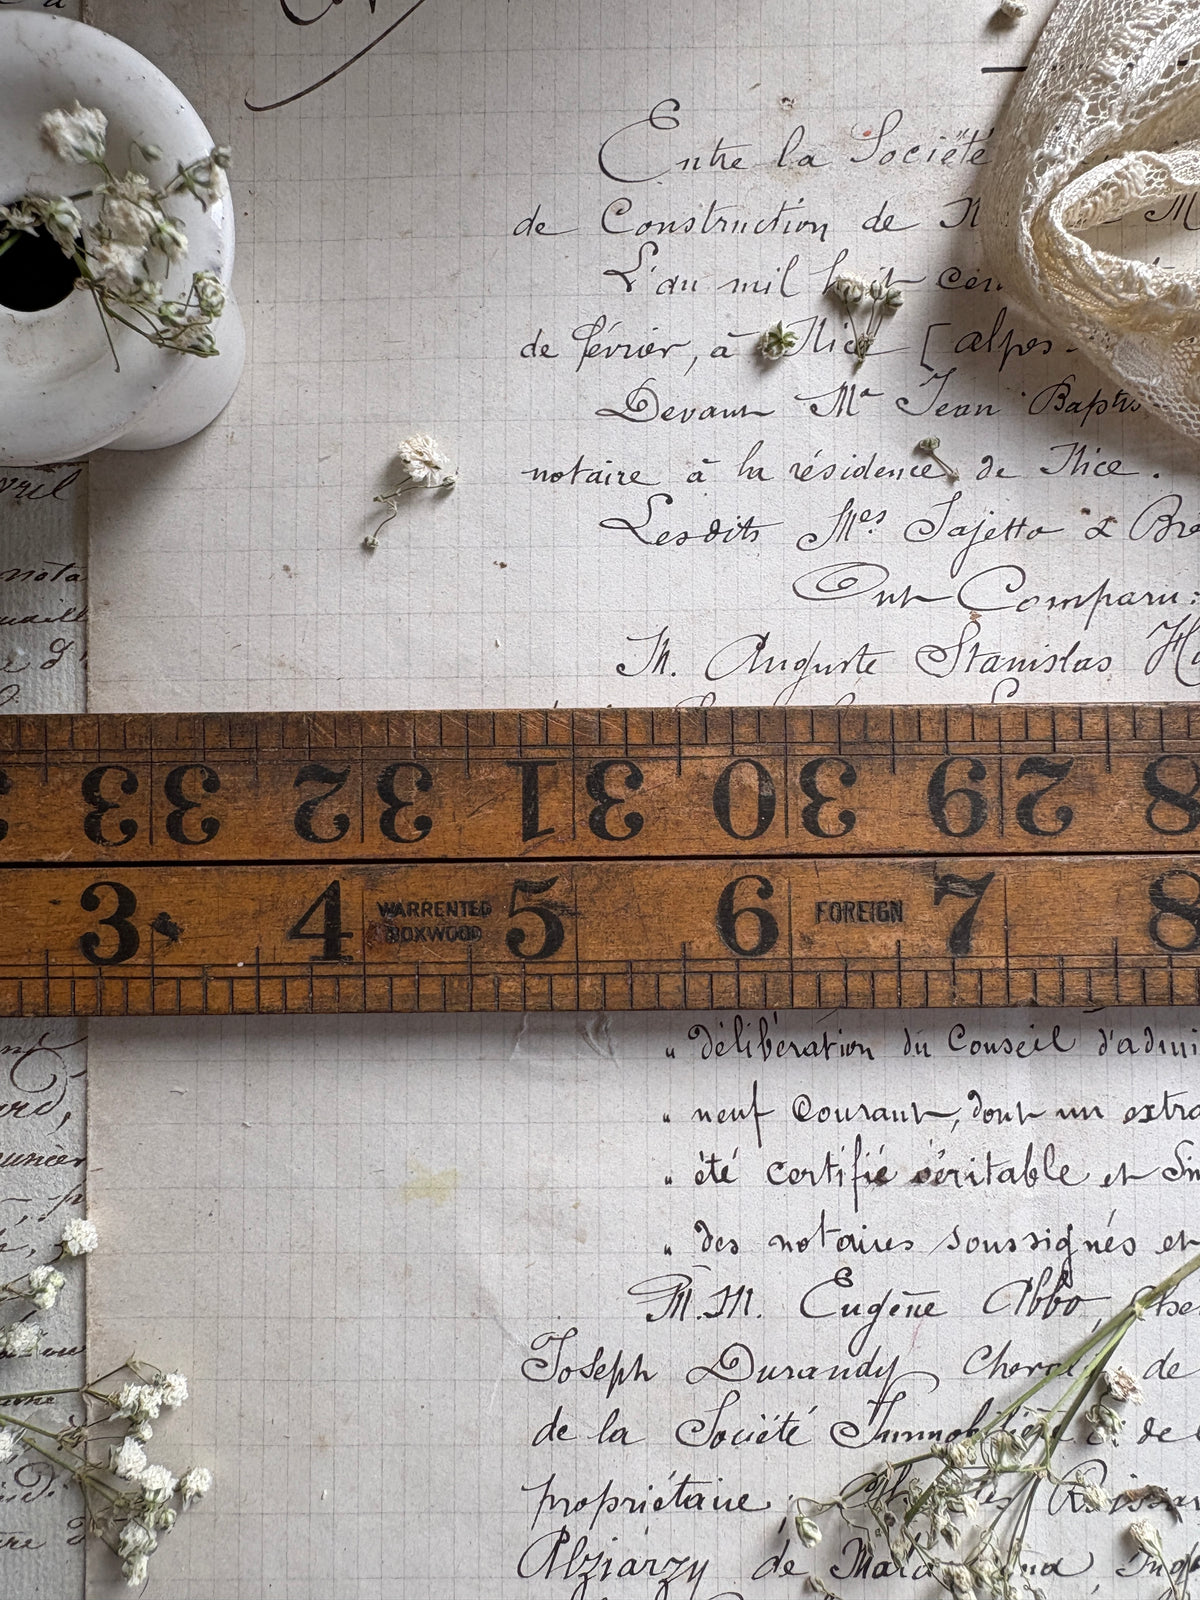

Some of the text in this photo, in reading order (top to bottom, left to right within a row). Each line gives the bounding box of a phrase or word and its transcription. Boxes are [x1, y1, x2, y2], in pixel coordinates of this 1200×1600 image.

[598, 98, 752, 184] Entre
[777, 125, 832, 168] la
[513, 204, 579, 236] de
[601, 197, 829, 242] Construction
[862, 200, 921, 233] de
[717, 254, 800, 298] mil
[520, 329, 559, 359] de
[710, 331, 761, 358] à
[595, 378, 775, 423] Devant
[896, 368, 1001, 418] Jean
[521, 455, 661, 486] notaire
[686, 458, 721, 483] à
[737, 439, 775, 482] la
[789, 449, 947, 482] résidence
[976, 455, 1022, 480] de
[704, 631, 896, 706] Auguste
[916, 619, 1113, 679] Stanislas
[78, 869, 1200, 966] 3 4 5 6 7 8
[376, 900, 493, 918] WARRENTED
[814, 900, 903, 924] FOREIGN
[385, 925, 483, 943] BOXWOOD
[688, 1011, 875, 1062] délibération
[903, 1028, 931, 1058] du
[948, 1023, 1076, 1059] Conseil
[691, 1080, 775, 1148] neuf
[967, 1089, 1047, 1125] dont
[1055, 1104, 1104, 1119] un
[694, 1147, 738, 1186] été
[1099, 1162, 1160, 1188] et
[694, 1219, 739, 1254] des
[768, 1209, 914, 1254] notaires
[928, 1208, 1136, 1288] soussignés
[521, 1327, 658, 1398] Joseph
[1143, 1348, 1200, 1380] de
[532, 1406, 578, 1446] de
[588, 1408, 646, 1445] la
[675, 1389, 814, 1449] Société
[752, 1539, 810, 1574] de
